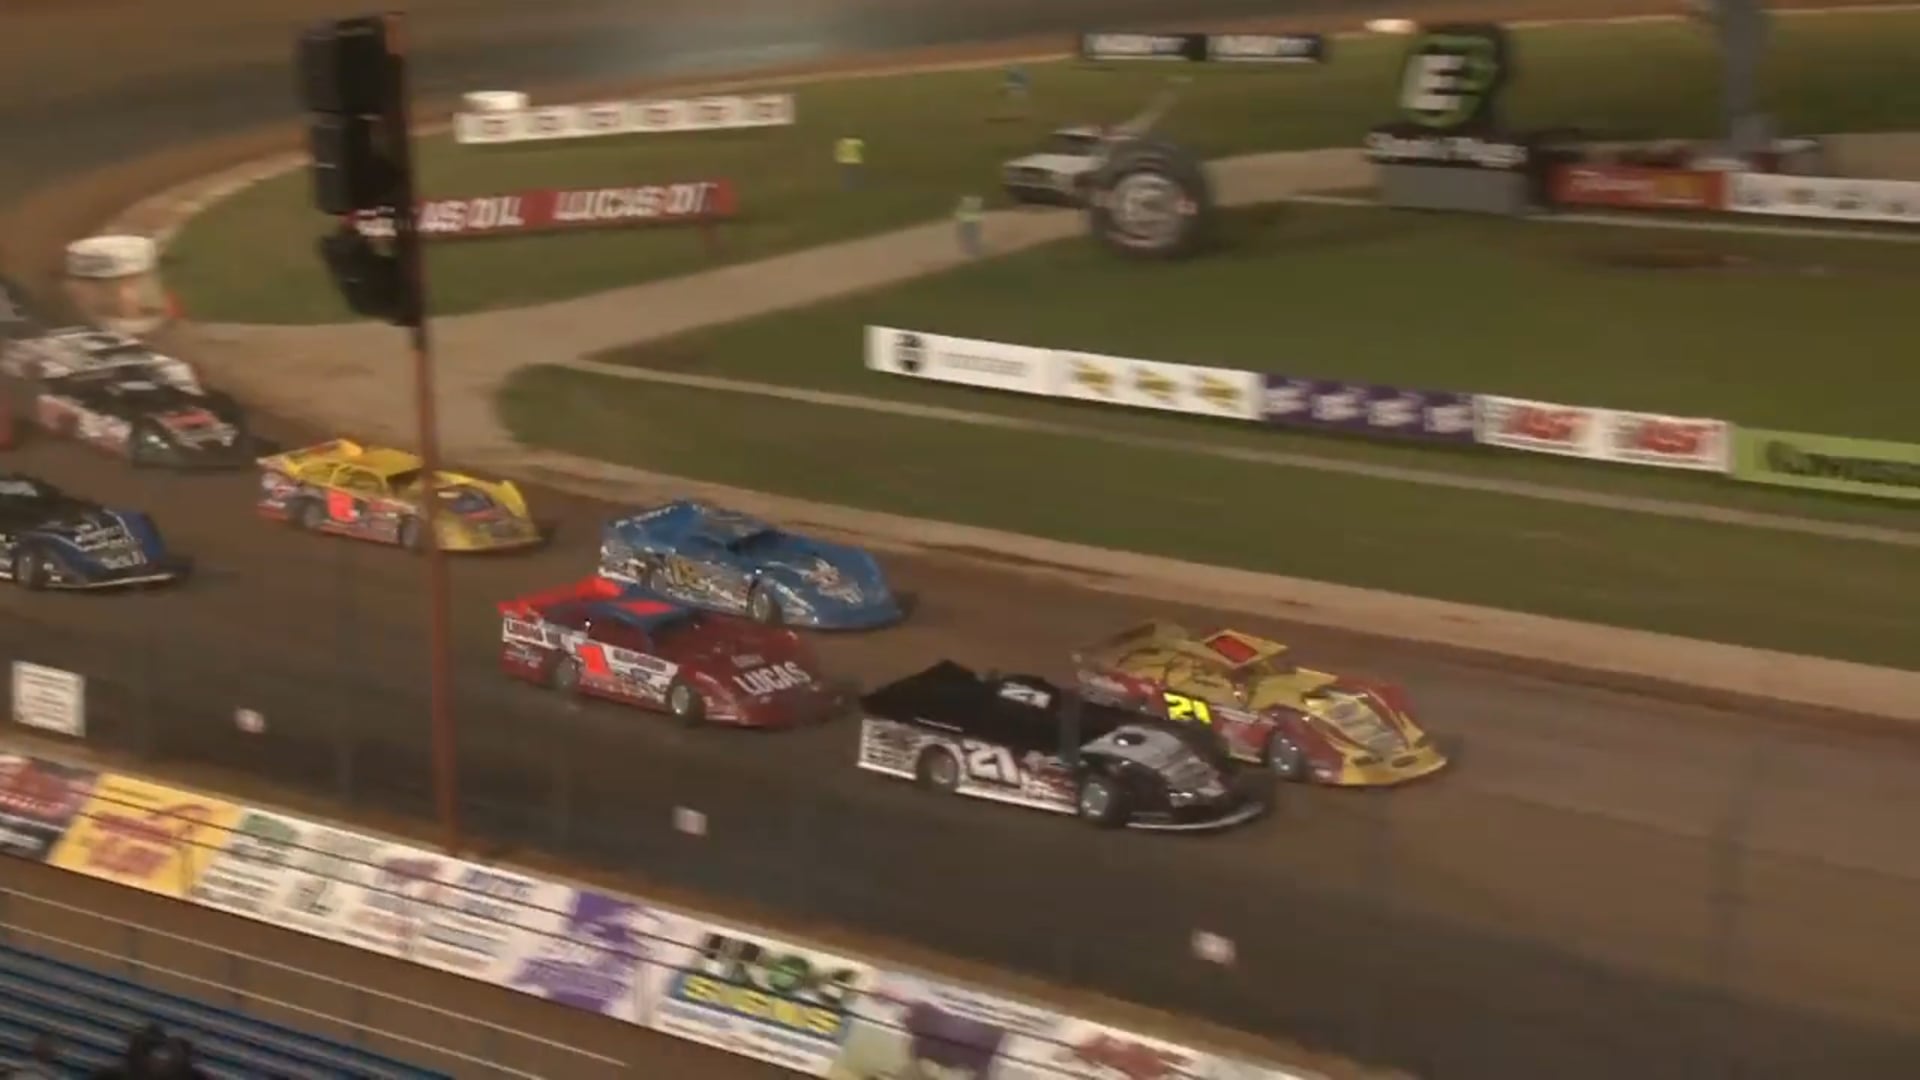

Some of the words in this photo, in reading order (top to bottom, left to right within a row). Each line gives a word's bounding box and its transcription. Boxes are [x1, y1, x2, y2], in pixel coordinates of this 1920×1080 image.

[732, 661, 812, 696] LUCAS
[999, 681, 1052, 709] 21
[964, 738, 1021, 789] 21
